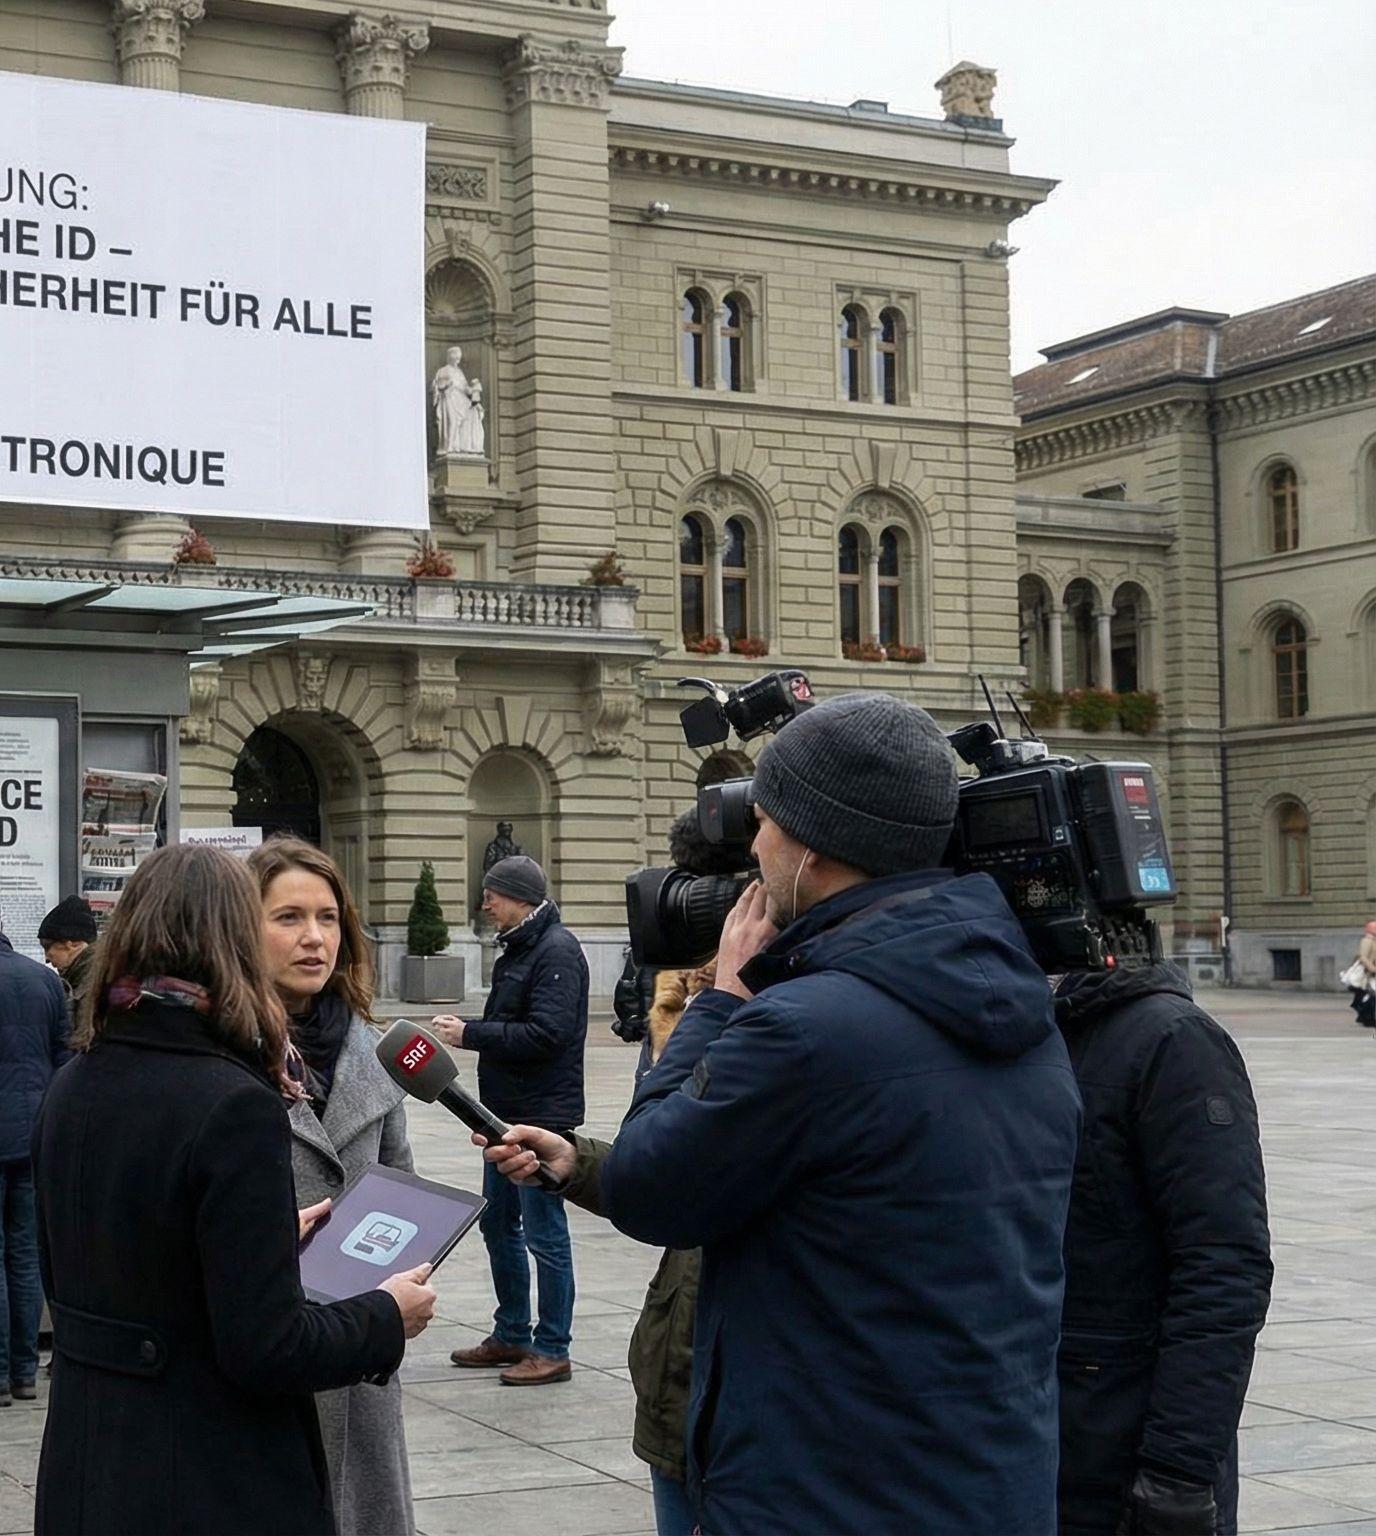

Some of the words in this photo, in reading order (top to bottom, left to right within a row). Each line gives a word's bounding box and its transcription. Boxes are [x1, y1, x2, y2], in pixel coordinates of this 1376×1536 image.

[55, 223, 96, 261] ID
[180, 280, 260, 330] FÜR
[272, 297, 373, 340] ALLE
